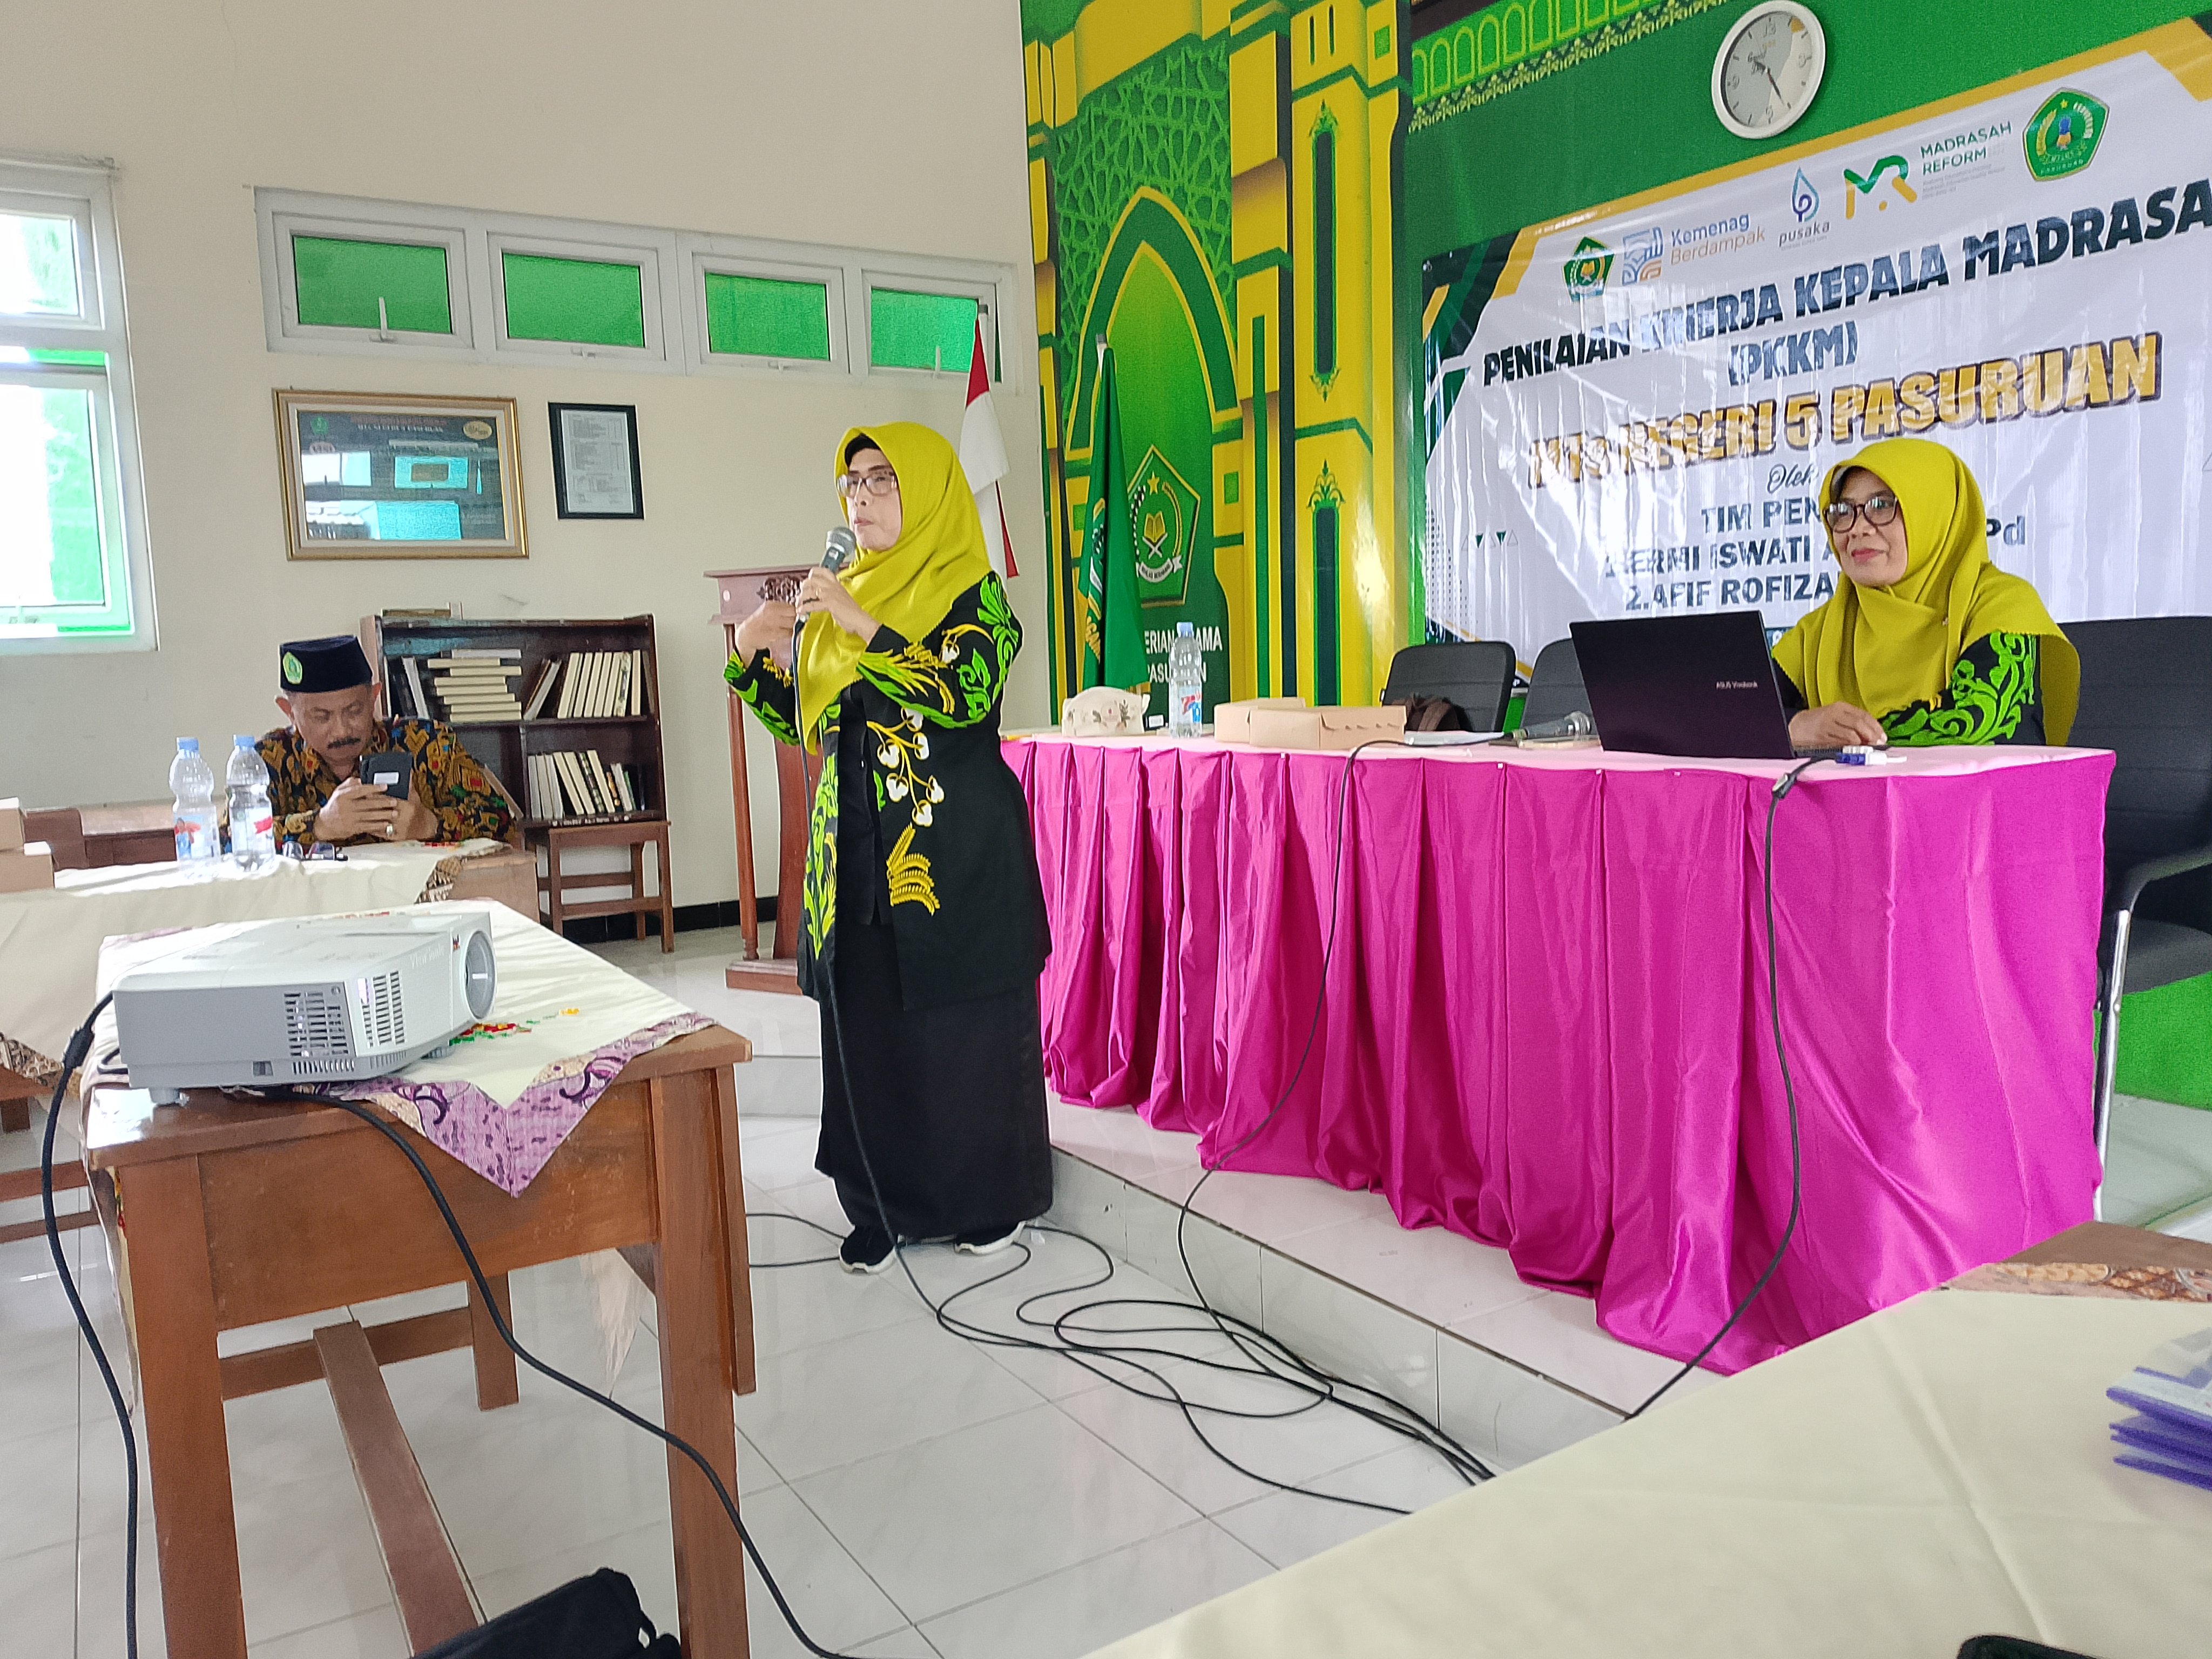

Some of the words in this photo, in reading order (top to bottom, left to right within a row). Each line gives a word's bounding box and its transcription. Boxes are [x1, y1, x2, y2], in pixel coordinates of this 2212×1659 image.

[1920, 121, 2012, 159] MADRASAH
[1923, 147, 1986, 176] REFORM
[1671, 214, 1750, 247] Kemenag
[1671, 226, 1765, 266] Berdampak
[1778, 221, 1830, 248] pusaka
[1483, 319, 1630, 387] PENILAIAN
[1794, 243, 1949, 318] KEPALA
[1963, 178, 2212, 281] MADRASA
[1785, 390, 1821, 450] 5
[1831, 332, 2162, 444] PASURUAN
[1702, 503, 1751, 534] TIM
[1711, 535, 1810, 570] ISWATI
[1721, 571, 1842, 605] ROFIZA
